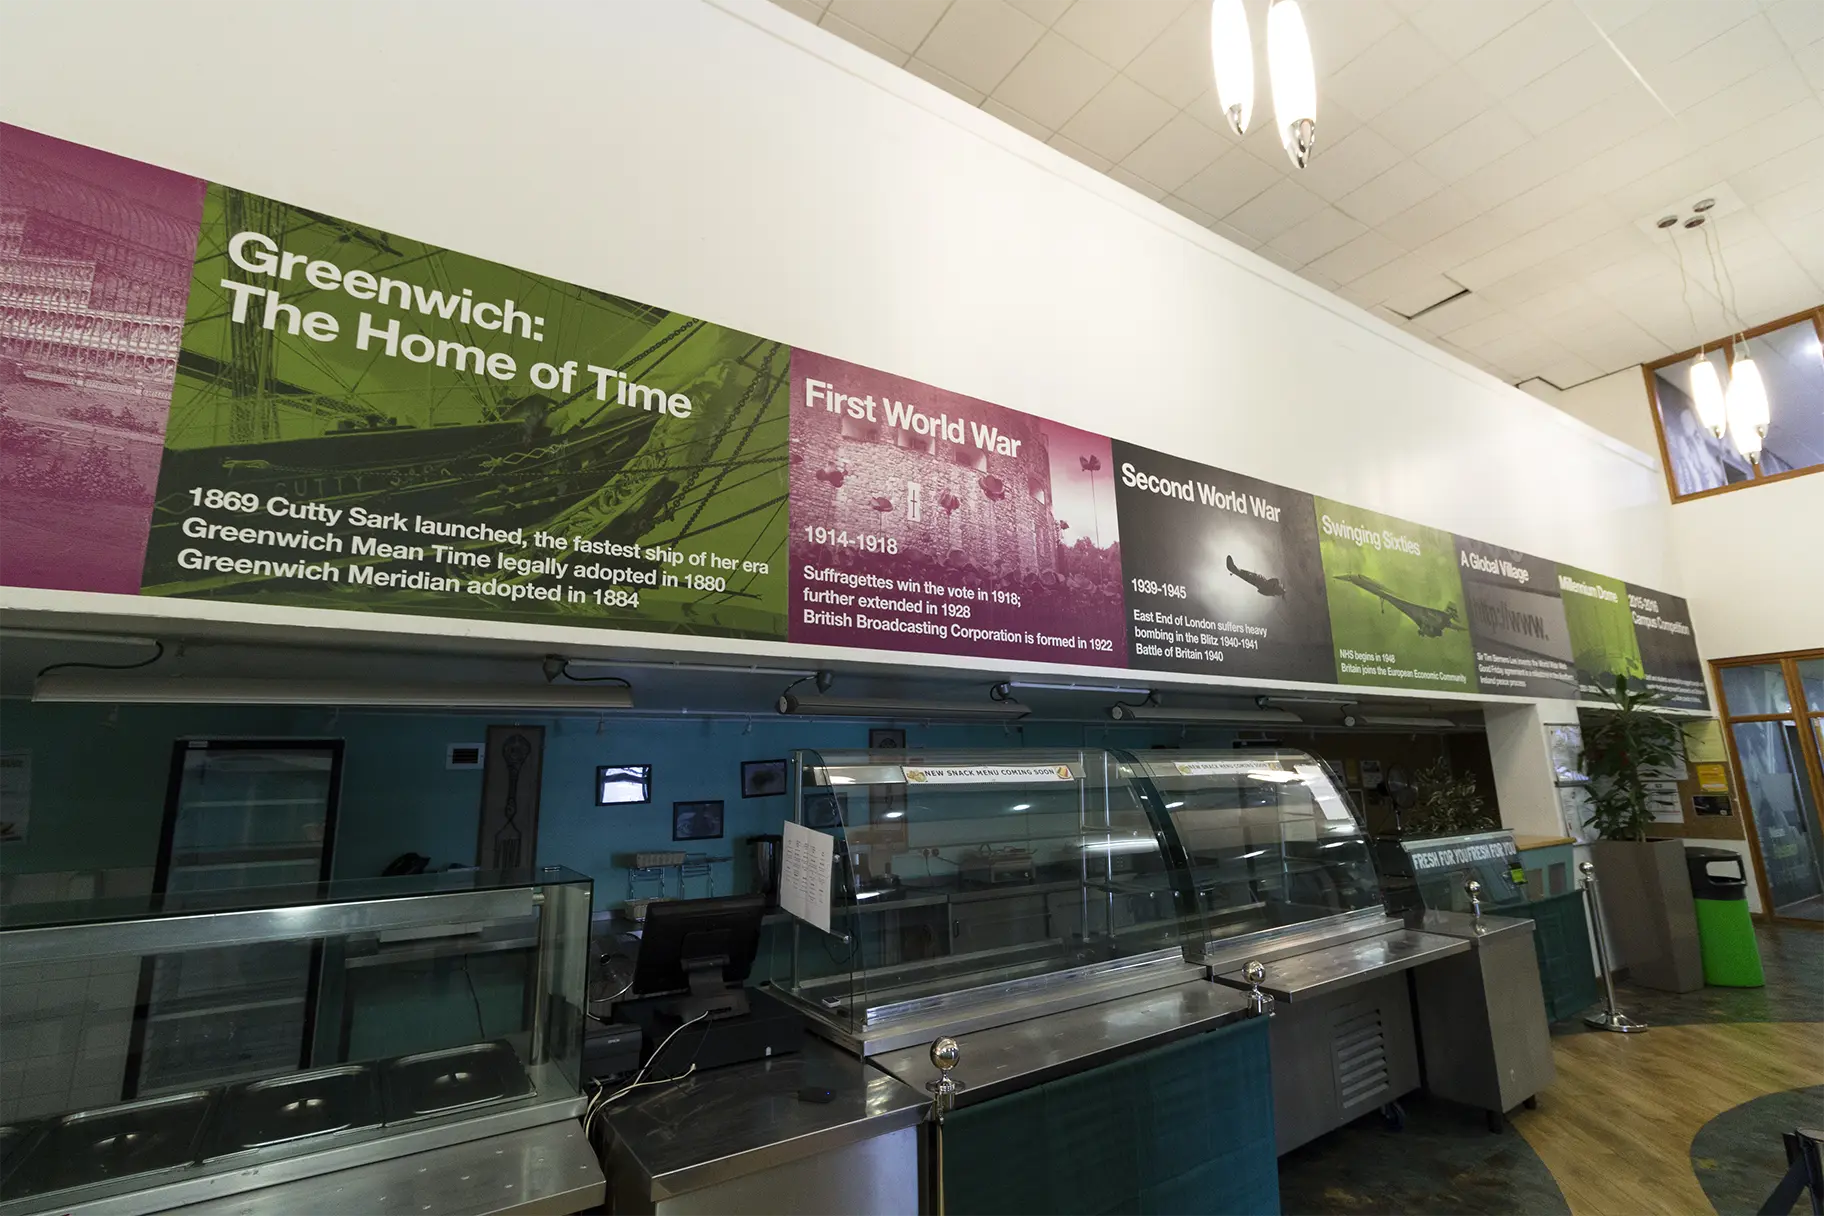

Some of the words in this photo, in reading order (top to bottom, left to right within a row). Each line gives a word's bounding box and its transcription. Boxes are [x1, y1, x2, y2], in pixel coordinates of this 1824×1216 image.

[228, 231, 544, 342] Greenwich:
[220, 279, 339, 342] The
[356, 312, 516, 380] Home
[530, 360, 578, 394] of
[587, 364, 692, 418] Time
[806, 377, 877, 423] First
[882, 397, 965, 445] World
[970, 421, 1021, 458] War
[1121, 462, 1195, 502] Second
[1196, 481, 1248, 515] World
[1249, 495, 1281, 523] War
[189, 487, 259, 512] 1869
[266, 497, 343, 526] Cutty
[348, 507, 408, 531] Sark
[415, 515, 527, 548] launched,
[533, 531, 568, 550] the
[573, 536, 641, 559] fastest
[645, 546, 684, 567] ship
[688, 552, 707, 566] of
[711, 553, 739, 570] her
[743, 561, 768, 574] era
[804, 525, 898, 555] 1914-1918
[1322, 514, 1381, 551] Swinging
[1382, 530, 1421, 556] Sixties
[182, 517, 343, 552] Greenwich
[351, 536, 424, 561] Mean
[431, 544, 491, 568] Time
[497, 552, 568, 579] legally
[573, 563, 657, 585] adopted
[662, 571, 678, 587] in
[684, 574, 726, 592] 1880
[1461, 550, 1470, 568] A
[1469, 553, 1499, 575] Global
[1499, 560, 1529, 584] Village
[177, 548, 339, 582] Greenwich
[348, 564, 460, 592] Meridian
[467, 578, 561, 601] adopted
[568, 586, 586, 603] in
[593, 589, 639, 608] 1884
[804, 565, 894, 590] Suffragettes
[896, 578, 921, 593] win
[923, 581, 945, 596] the
[947, 586, 975, 600] vote
[977, 587, 988, 601] in
[991, 590, 1021, 608] 1918;
[1131, 578, 1187, 599] 1939-1945
[803, 587, 855, 606] further
[858, 596, 923, 613] extended
[926, 601, 938, 615] in
[941, 603, 971, 618] 1928
[804, 609, 852, 627] British
[857, 614, 947, 639] Broadcasting
[951, 623, 1022, 643] Corporation
[1024, 631, 1034, 644] is
[1036, 632, 1075, 648] formed
[1077, 636, 1087, 649] in
[1089, 638, 1113, 652] 1922
[1133, 609, 1154, 623] East
[1155, 612, 1173, 625] End
[1174, 615, 1183, 626] of
[1184, 616, 1216, 630] London
[1217, 621, 1245, 633] suffers
[1245, 623, 1268, 638] heavy
[1134, 626, 1174, 644] bombing
[1175, 630, 1184, 642] in
[1185, 632, 1199, 644] the
[1200, 633, 1219, 646] Blitz
[1220, 635, 1258, 650] 1940-1941
[1136, 643, 1163, 656] Battle
[1164, 646, 1174, 657] of
[1175, 646, 1203, 660] Britain
[1204, 650, 1224, 662] 1940
[1339, 649, 1354, 660] NHS
[1354, 650, 1375, 662] begins
[1375, 652, 1381, 662] in
[1381, 653, 1396, 664] 1948
[1341, 662, 1362, 674] Britain
[1361, 664, 1377, 675] joins
[1377, 665, 1387, 675] the
[1387, 667, 1414, 678] European
[1414, 669, 1440, 680] Economic
[1439, 671, 1467, 684] Community
[947, 769, 974, 777] SNACK
[1412, 851, 1440, 870] FRESH
[1440, 850, 1455, 867] FOR
[1453, 848, 1470, 864] YOU
[1466, 845, 1492, 862] FRESH
[1489, 842, 1504, 858] FOR
[1502, 841, 1517, 856] YOU
